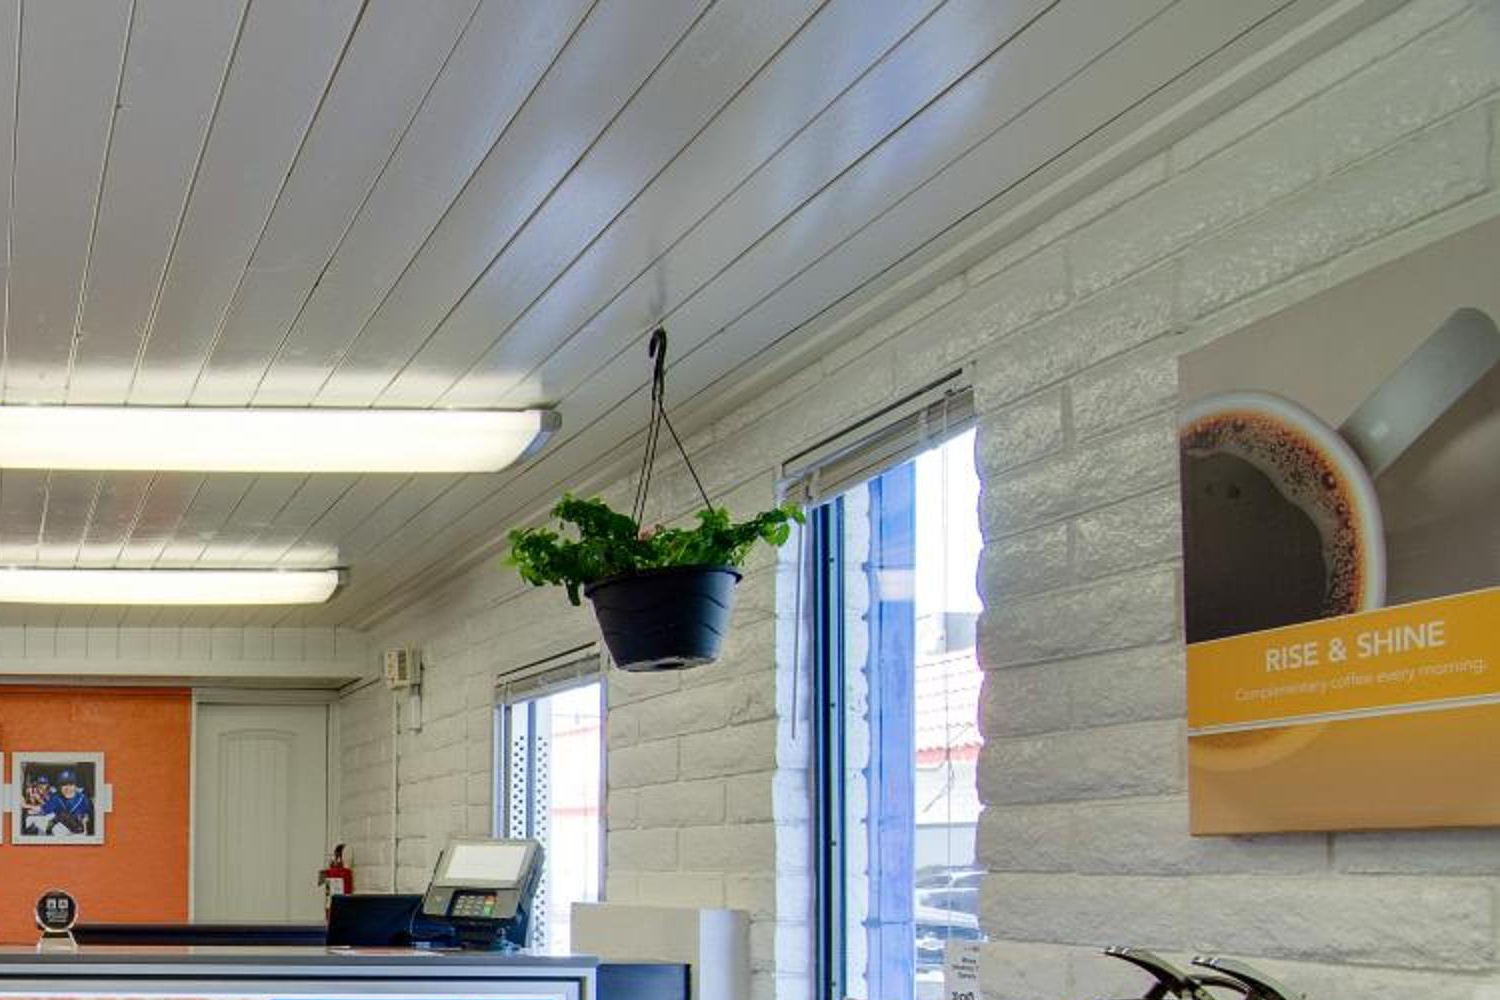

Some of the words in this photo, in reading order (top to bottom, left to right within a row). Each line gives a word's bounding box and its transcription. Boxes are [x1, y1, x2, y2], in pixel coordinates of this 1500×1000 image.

[1265, 641, 1319, 672] RISE
[1327, 637, 1348, 663] &
[1356, 620, 1446, 659] SHINE
[1331, 671, 1373, 689] coffee
[1379, 664, 1415, 685] every
